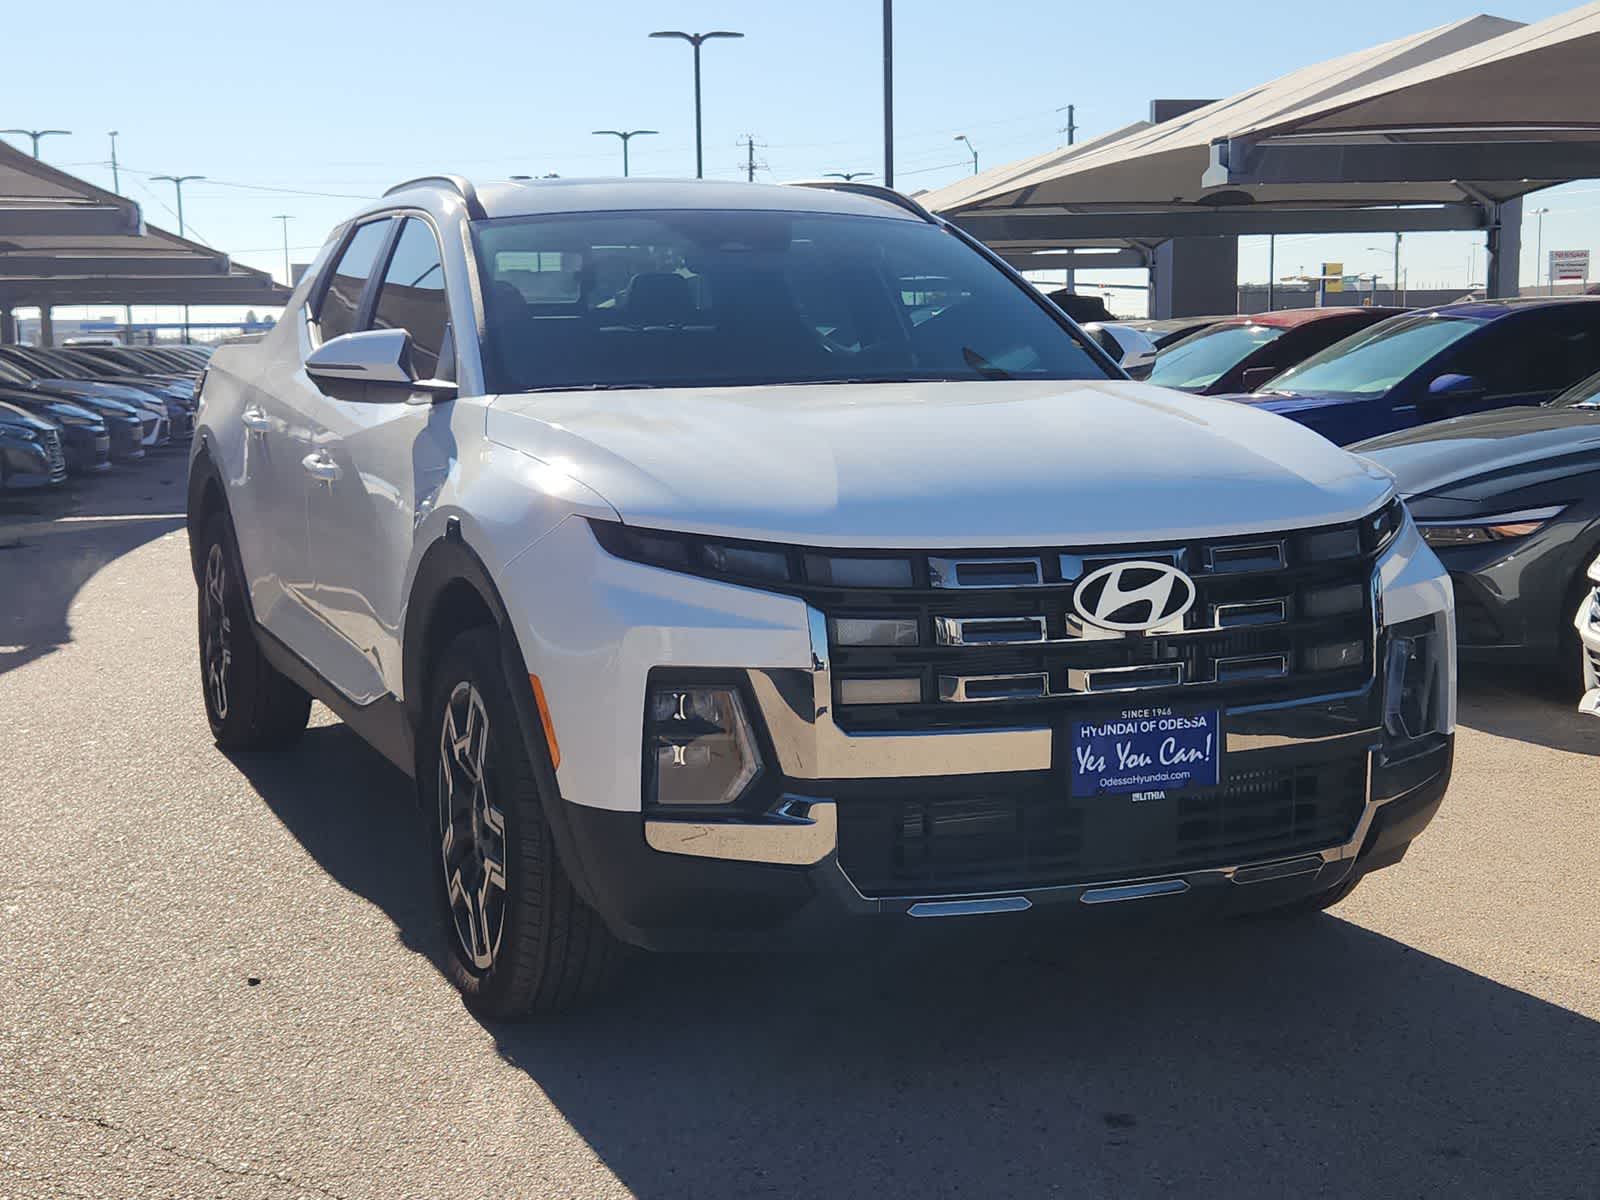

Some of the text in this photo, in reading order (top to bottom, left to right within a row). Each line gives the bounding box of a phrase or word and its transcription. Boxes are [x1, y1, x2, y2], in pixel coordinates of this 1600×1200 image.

[1121, 709, 1149, 719] SINCE
[1081, 716, 1207, 738] HYUNDAI OF ODESSA
[1076, 734, 1212, 774] Yes You Can!
[1099, 771, 1191, 787] OdessaHyundai.com
[1139, 791, 1165, 801] LITHIA
